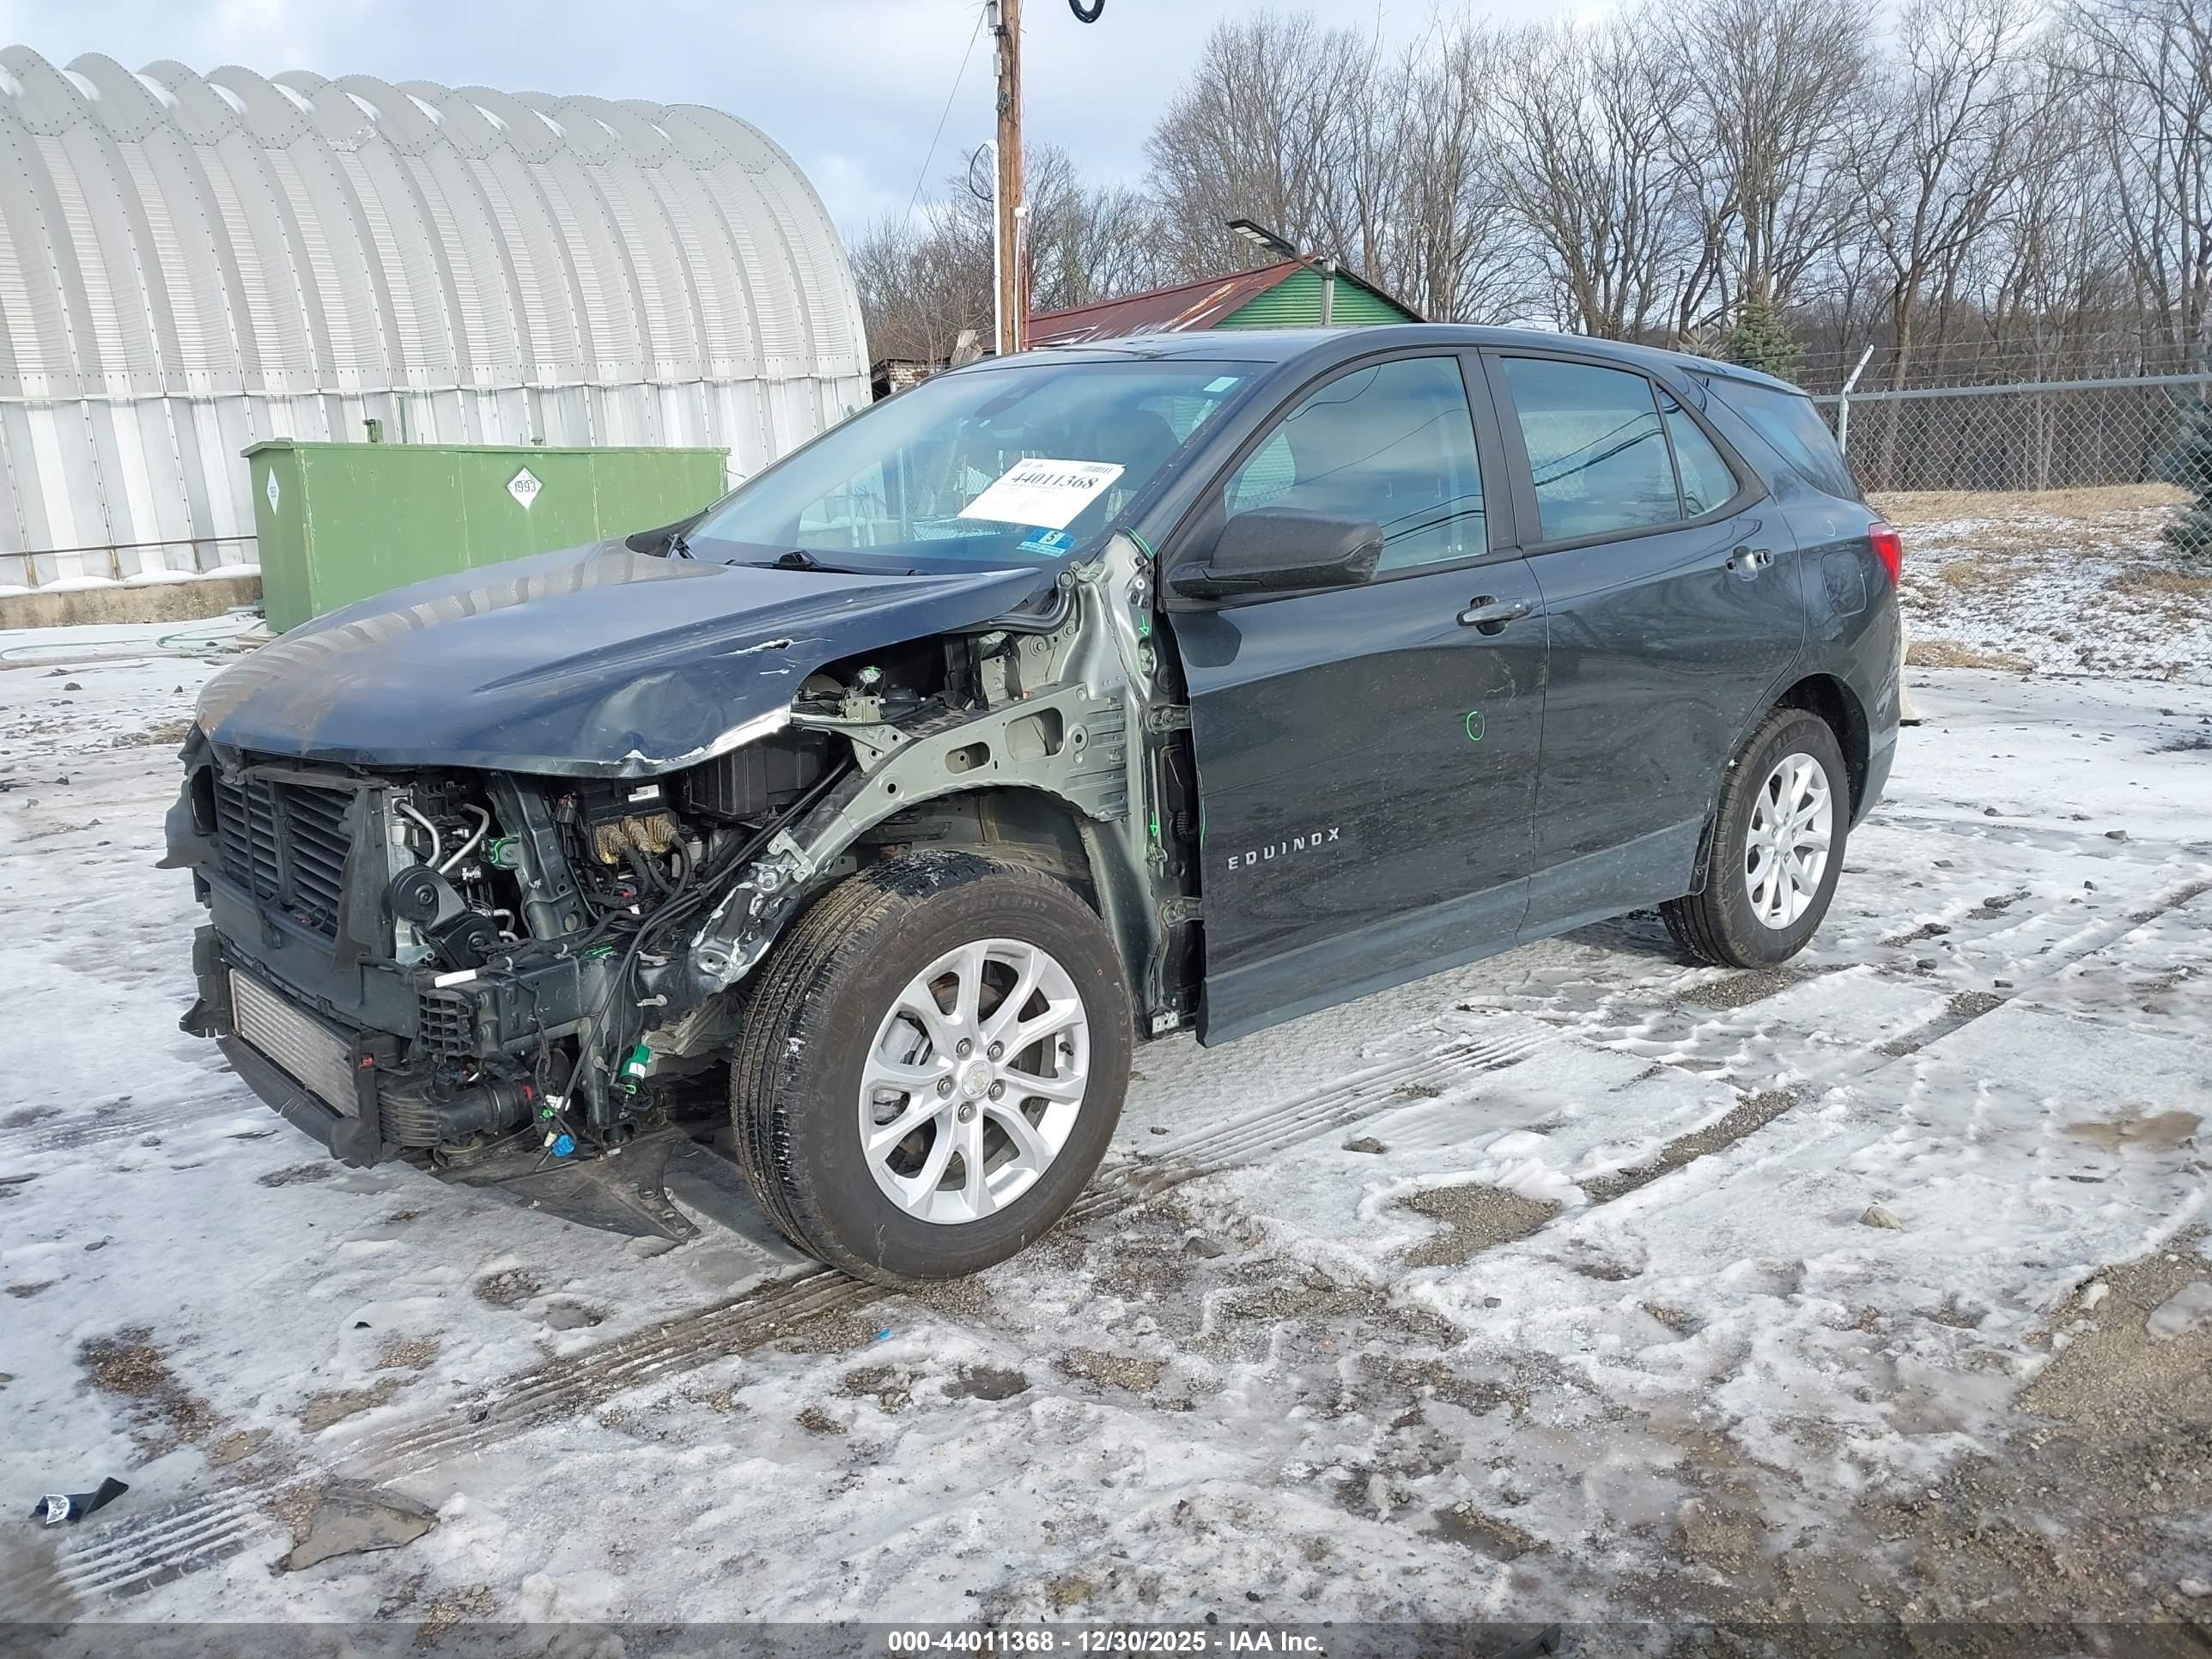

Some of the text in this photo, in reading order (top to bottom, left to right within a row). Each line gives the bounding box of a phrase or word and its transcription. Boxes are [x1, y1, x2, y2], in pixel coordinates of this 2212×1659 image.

[515, 480, 537, 493] 1993
[1011, 471, 1100, 489] 44011368
[1046, 532, 1059, 543] 5
[1227, 827, 1340, 871] EQUINOX
